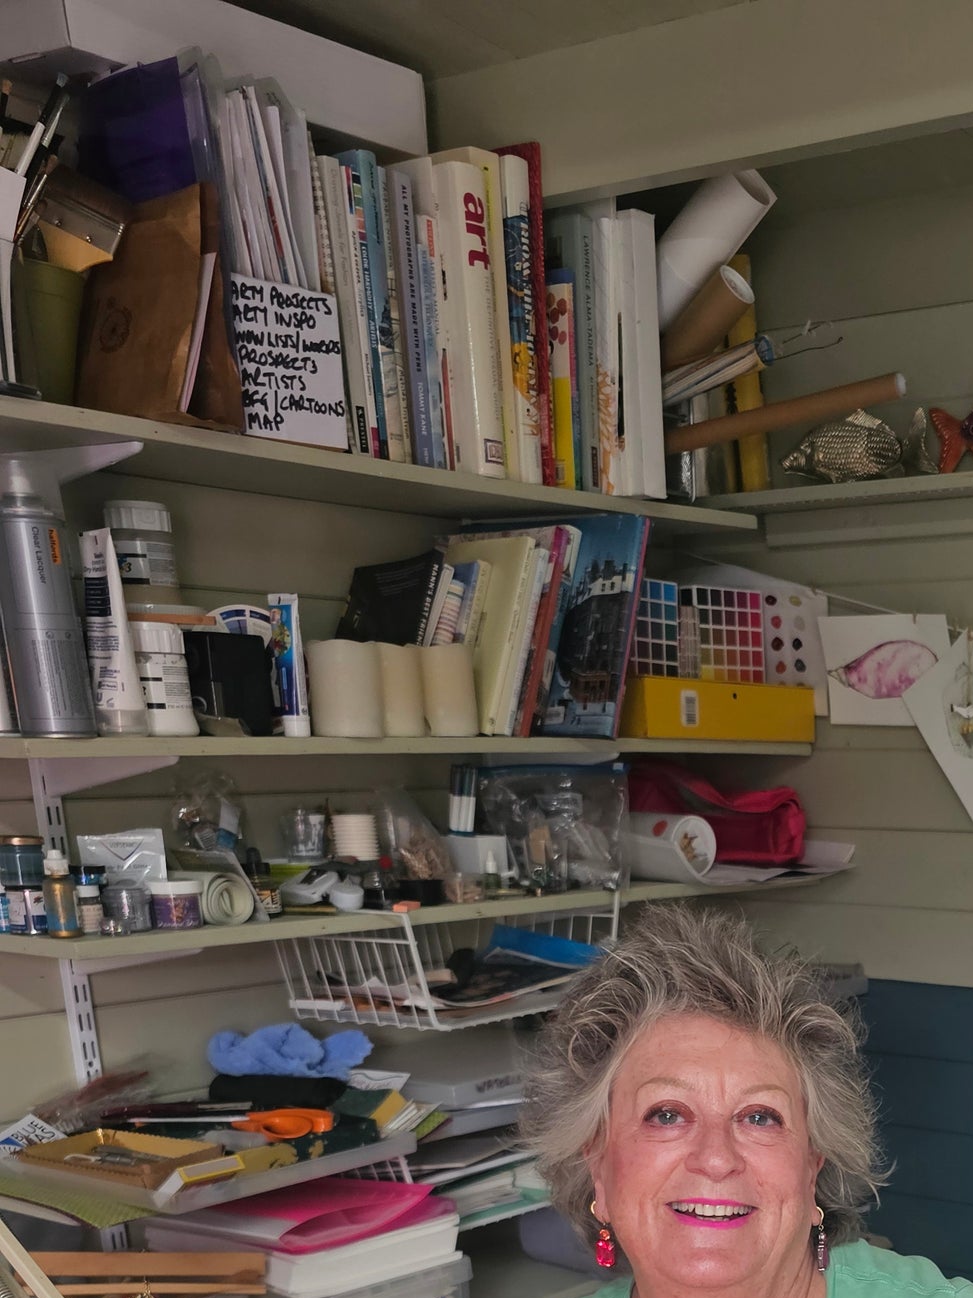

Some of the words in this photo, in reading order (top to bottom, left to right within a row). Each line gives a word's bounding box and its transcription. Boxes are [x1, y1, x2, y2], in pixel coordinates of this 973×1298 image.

[403, 204, 410, 216] MY
[463, 192, 491, 271] art
[404, 219, 414, 280] PHOTOGRAPHS
[583, 235, 592, 291] LAWRENCE
[270, 286, 332, 315] PROJECTS
[409, 282, 417, 299] ARE
[275, 311, 316, 331] INSPO
[486, 296, 494, 350] DEFINITIVE
[585, 294, 594, 367] ALMA-TADEMA
[413, 328, 421, 349] WITH
[238, 345, 318, 374] PROSPECTS
[489, 355, 497, 387] VISUAL
[241, 367, 306, 391] ARTISTS
[279, 394, 346, 417] CARTOONS
[416, 382, 426, 411] TOMMY
[247, 412, 285, 431] MAP
[419, 414, 428, 436] KANE
[31, 526, 41, 549] Clear
[48, 529, 59, 564] halfords
[35, 550, 47, 584] Lacquer
